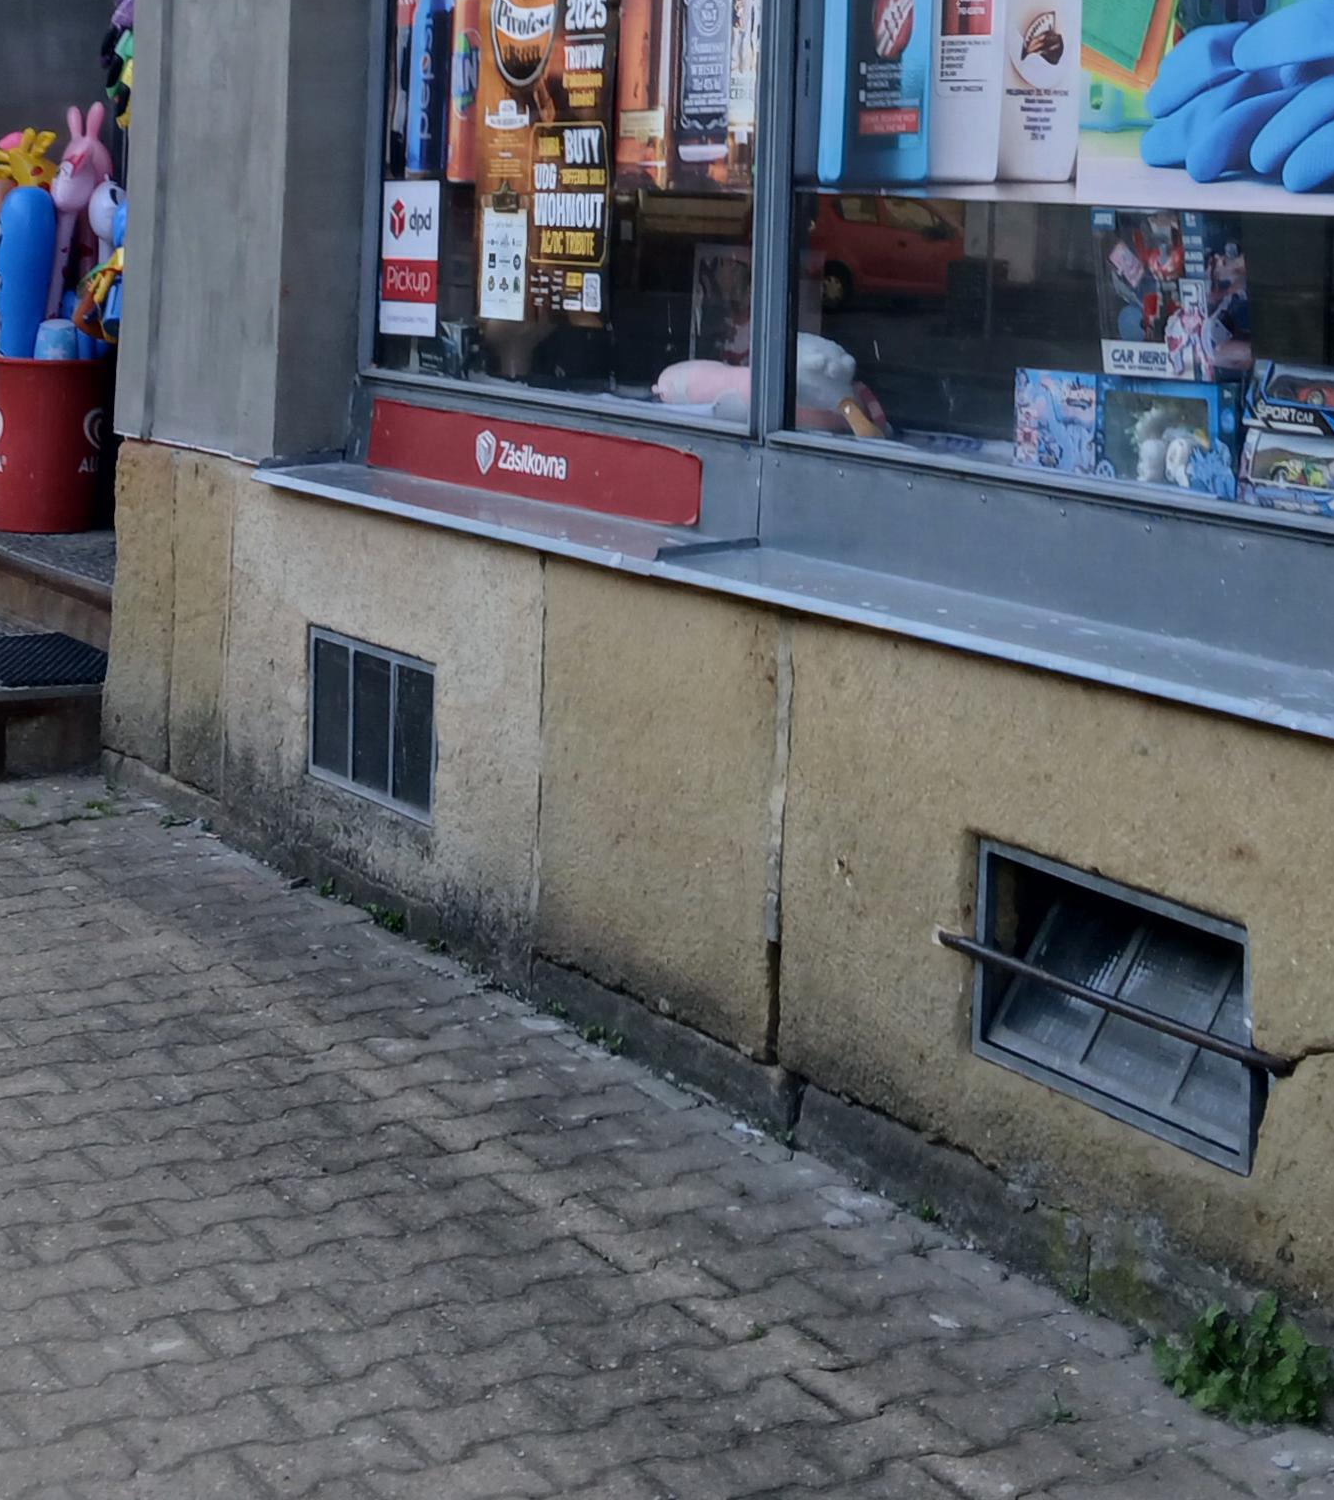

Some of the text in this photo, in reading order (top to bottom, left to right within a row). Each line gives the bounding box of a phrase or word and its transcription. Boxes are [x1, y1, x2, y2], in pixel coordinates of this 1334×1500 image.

[563, 128, 601, 165] BUTY
[409, 207, 432, 237] dpd
[386, 265, 431, 297] Pickup
[1111, 348, 1135, 364] CAR
[1257, 399, 1315, 424] SPORT CAR
[497, 440, 568, 480] Zásilkovna
